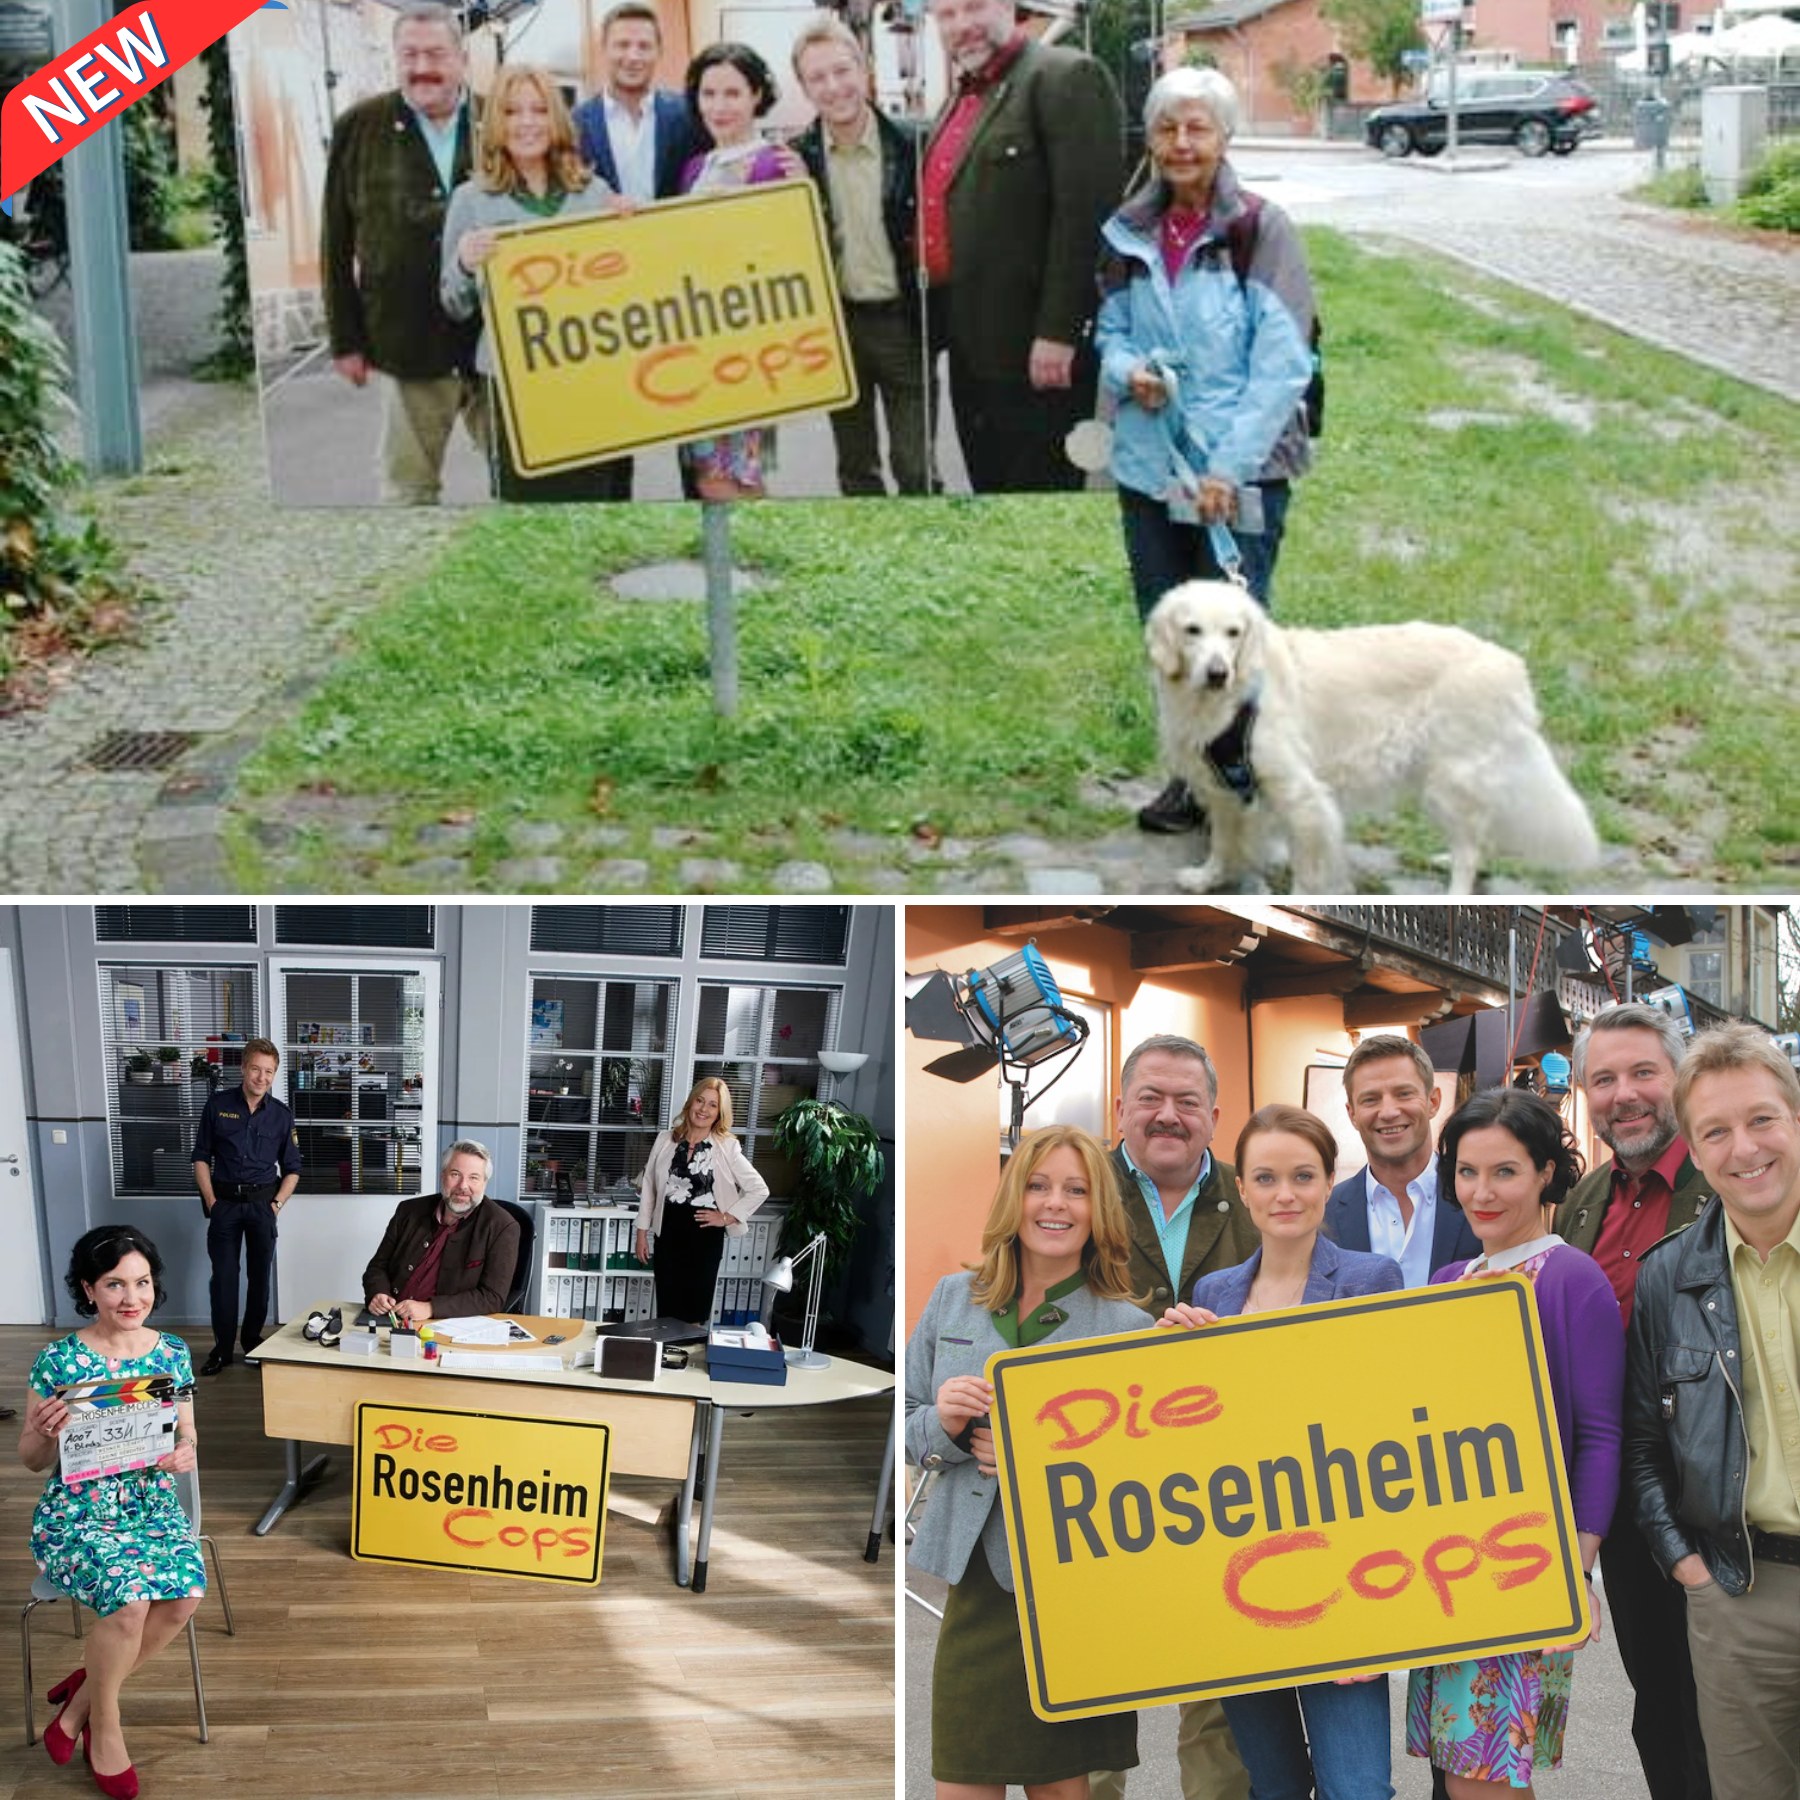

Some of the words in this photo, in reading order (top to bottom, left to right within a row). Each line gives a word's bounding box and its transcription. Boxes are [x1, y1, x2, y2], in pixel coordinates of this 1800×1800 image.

[508, 250, 632, 300] Die
[515, 263, 817, 374] Rosenheim
[633, 325, 834, 406] Cops
[81, 1404, 136, 1422] ROSENHEIM
[374, 1424, 459, 1453] Die
[1033, 1384, 1224, 1451] Die
[373, 1453, 588, 1518] Rosenheim
[1045, 1407, 1525, 1564] Rosenheim
[443, 1508, 593, 1562] Cops
[1223, 1511, 1553, 1630] Cops
